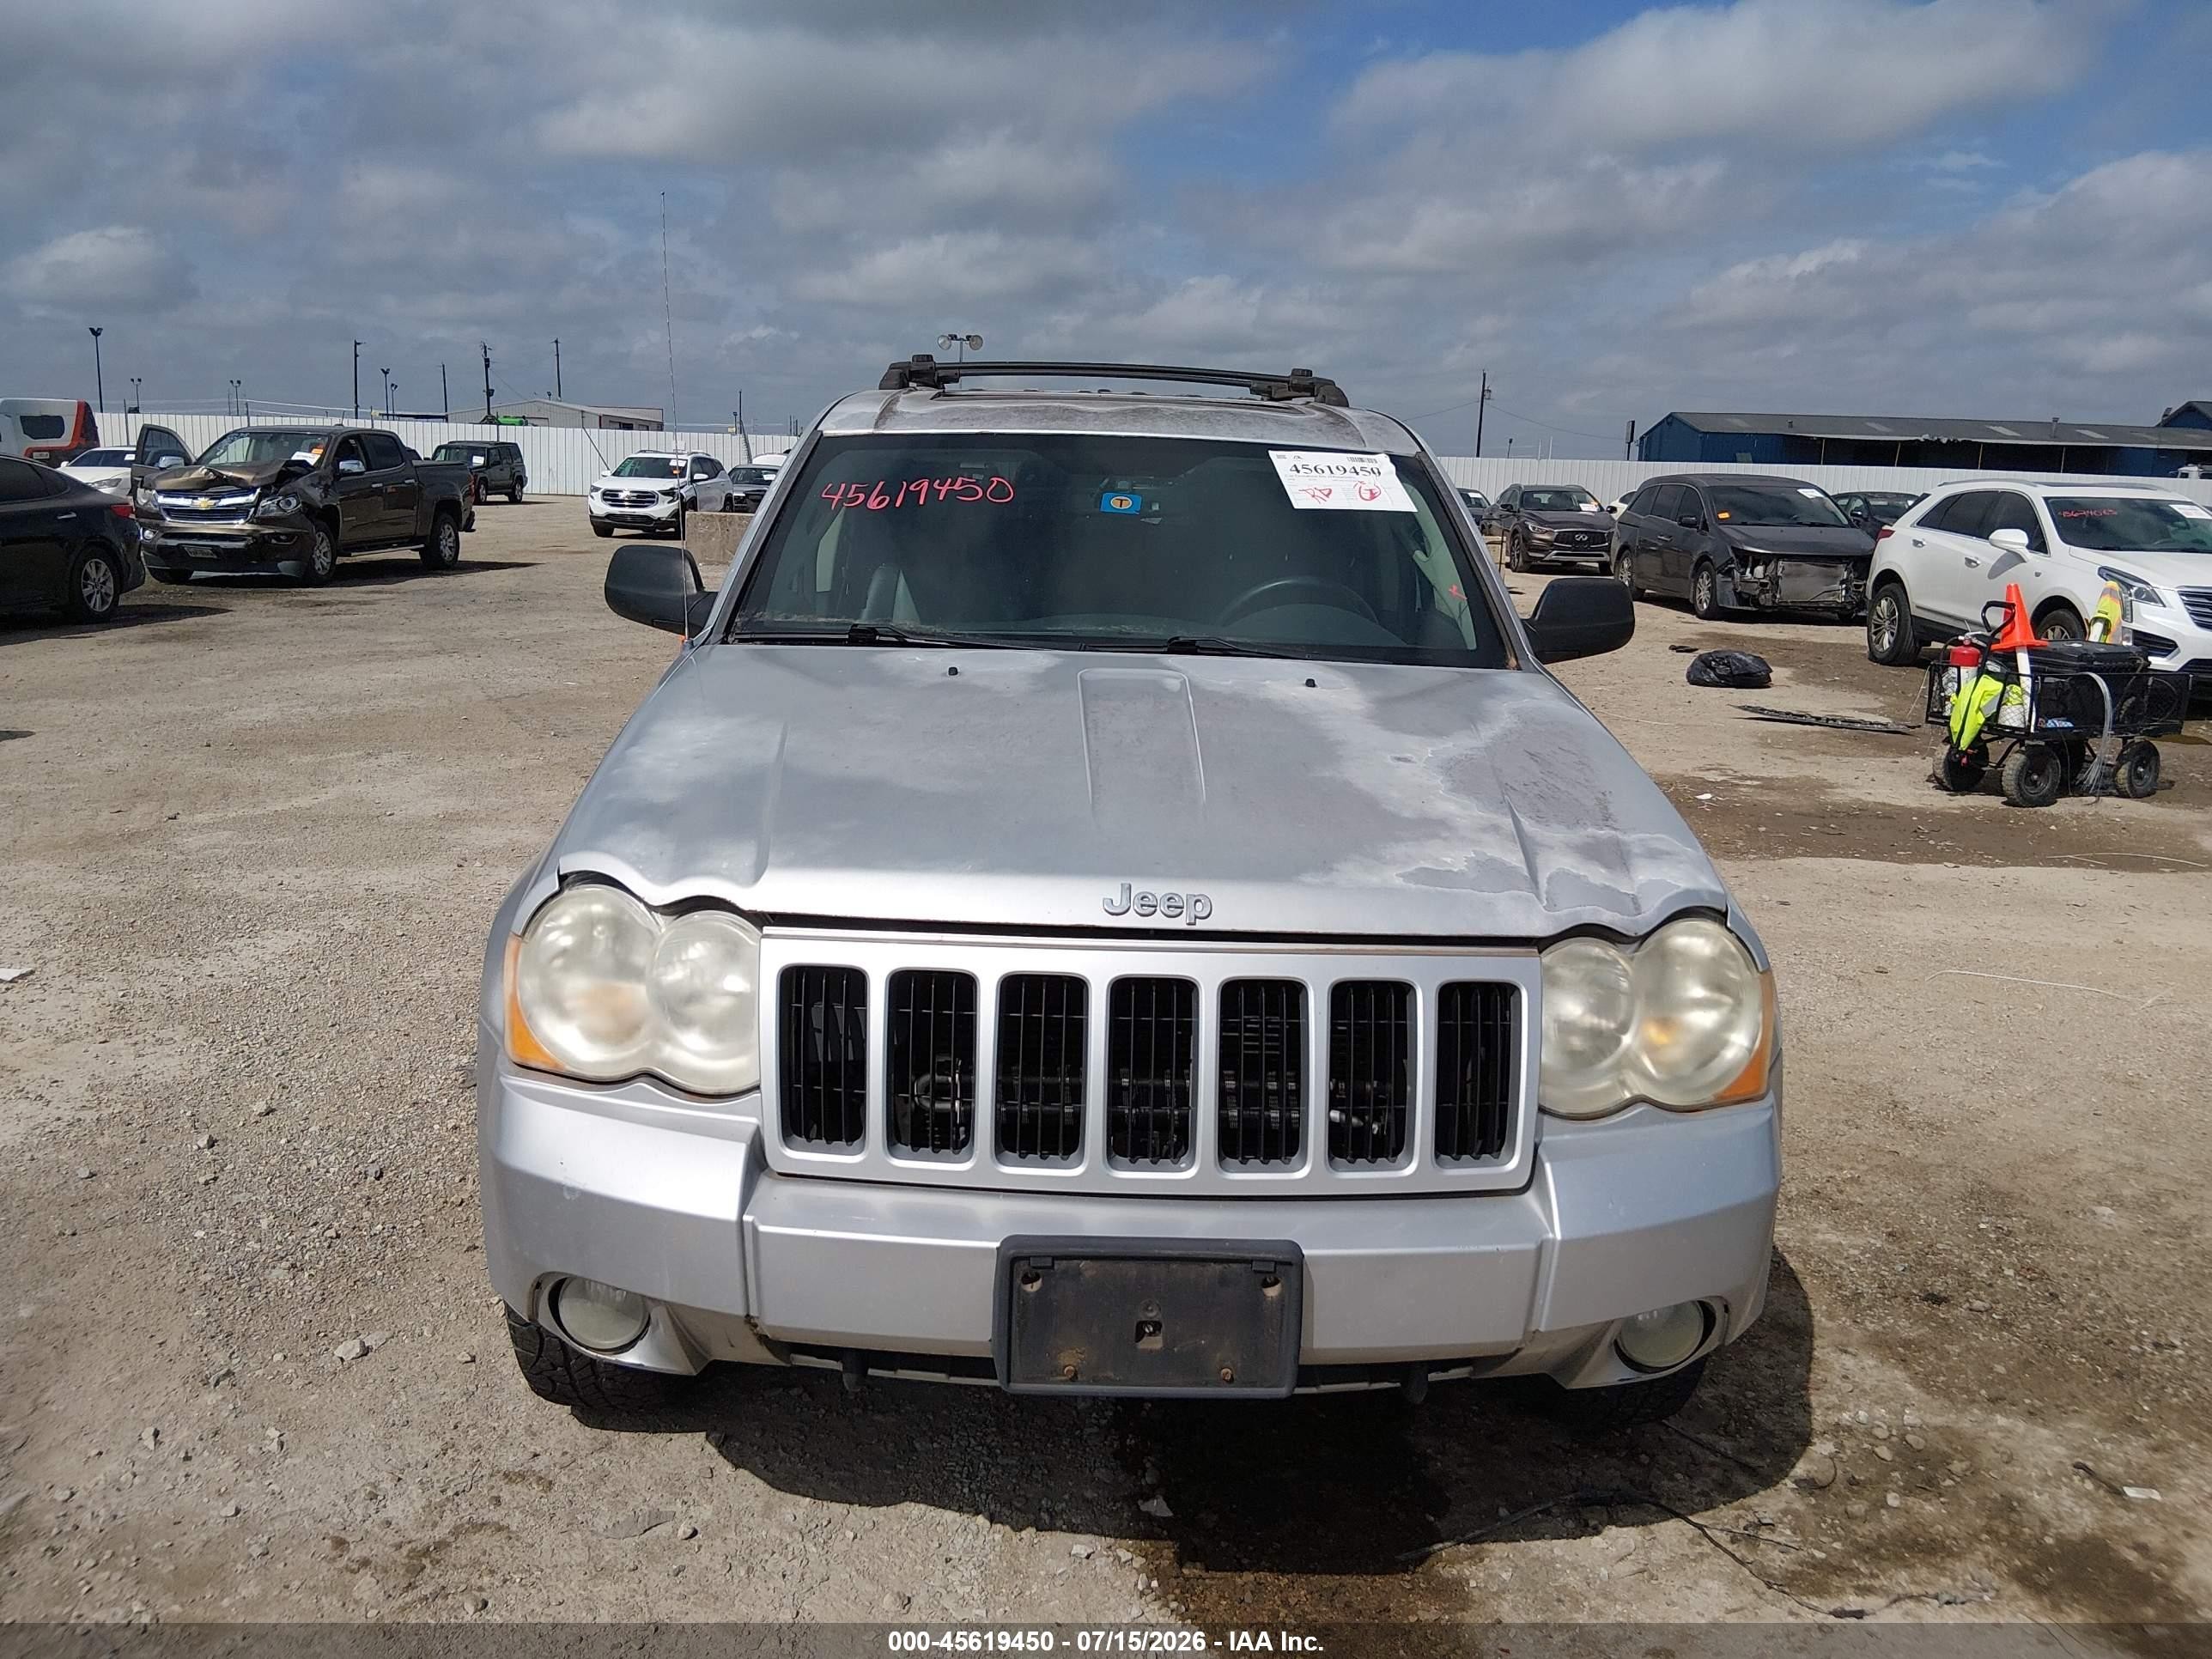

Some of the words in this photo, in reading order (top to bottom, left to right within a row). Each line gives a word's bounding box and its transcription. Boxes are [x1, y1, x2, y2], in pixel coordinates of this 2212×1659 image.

[1290, 464, 1382, 477] 45619450
[821, 476, 1015, 511] 45619450
[1103, 883, 1212, 926] Jeep
